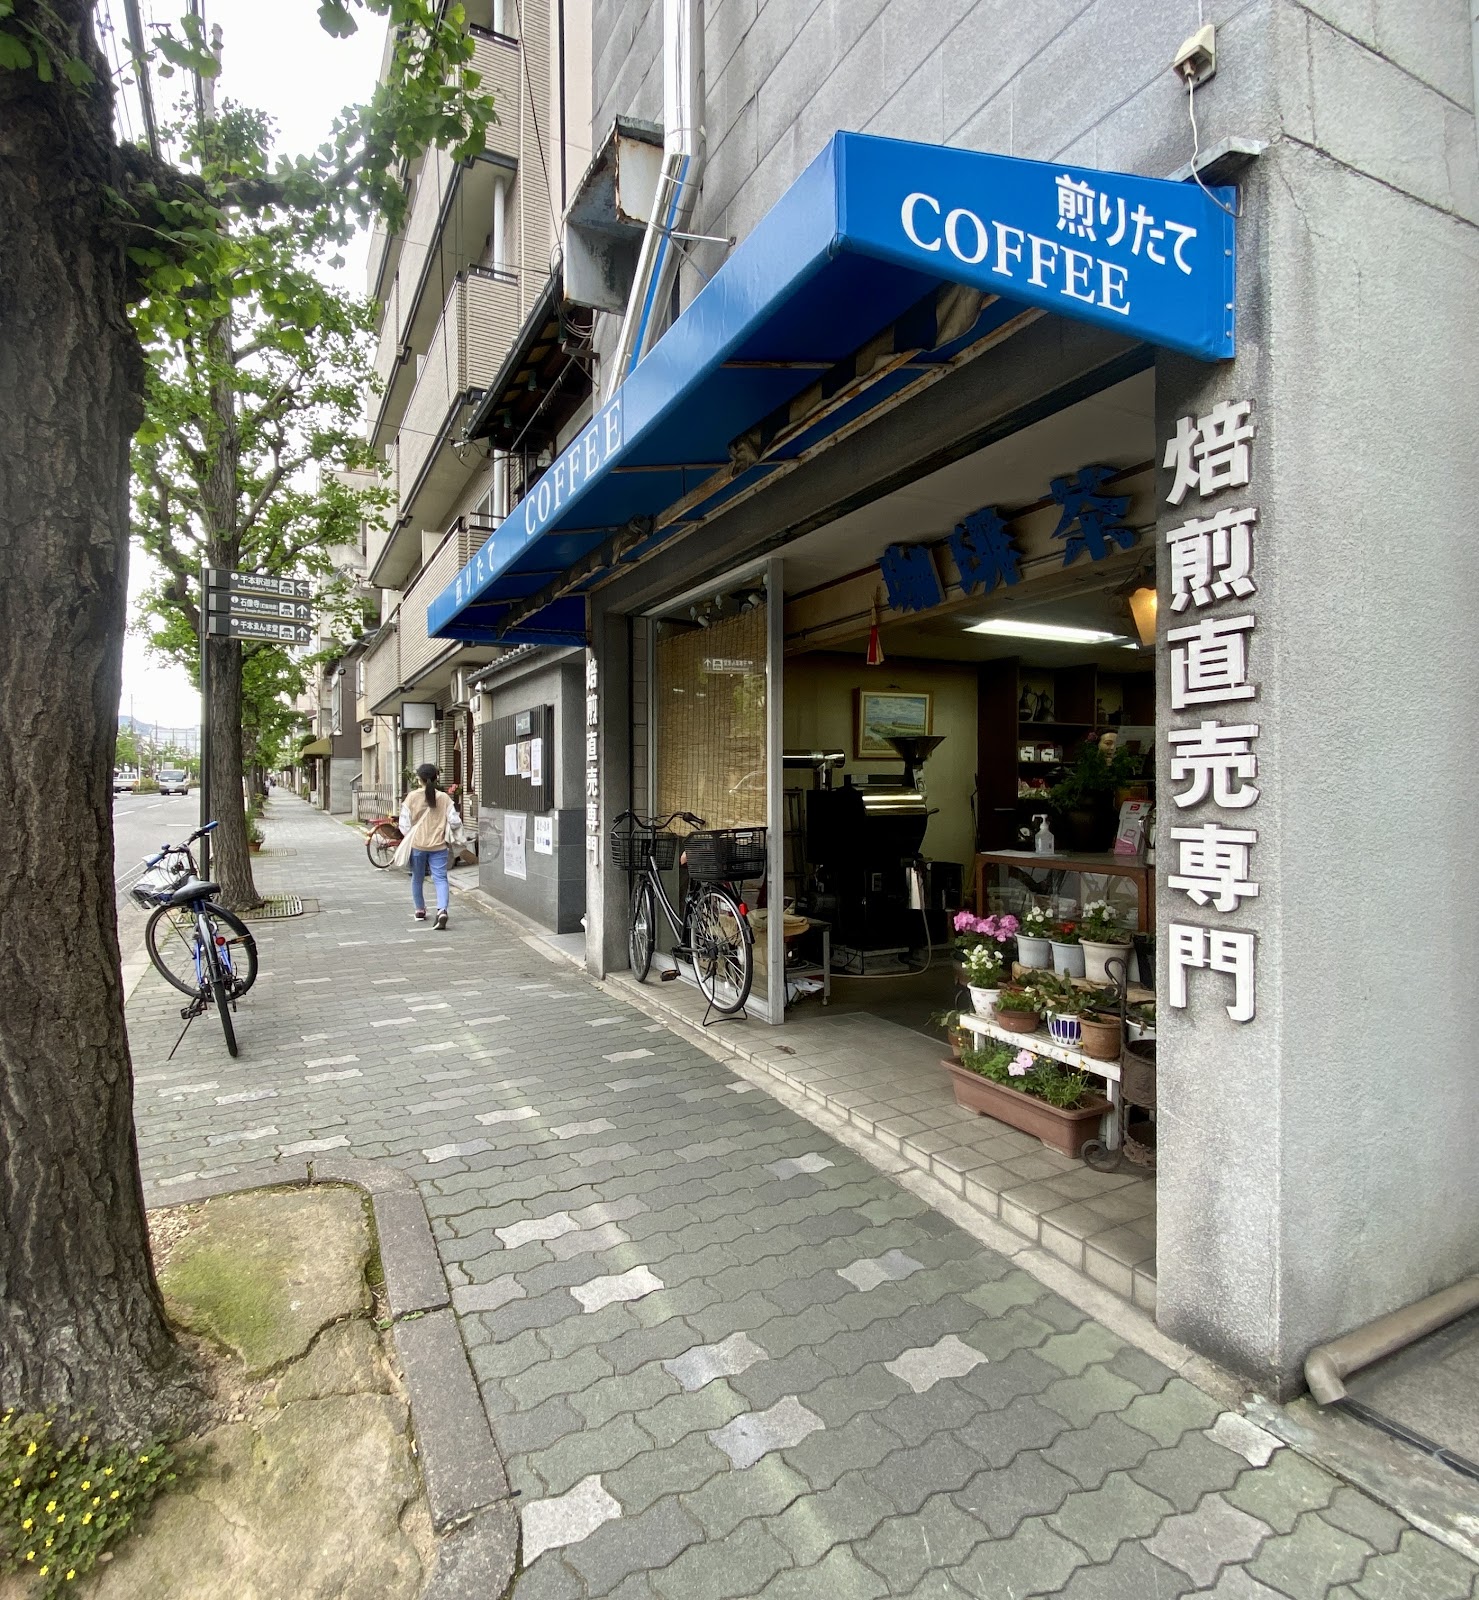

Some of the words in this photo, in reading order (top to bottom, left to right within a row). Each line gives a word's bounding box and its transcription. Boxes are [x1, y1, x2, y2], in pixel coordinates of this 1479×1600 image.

[901, 192, 1131, 316] COFFEE
[1055, 174, 1197, 275] 煎りたて
[525, 399, 622, 535] COFFEE
[455, 542, 495, 607] 煎りたて
[586, 658, 599, 867] 焙煎直売専門
[1163, 400, 1259, 1021] 焙煎直売専門
